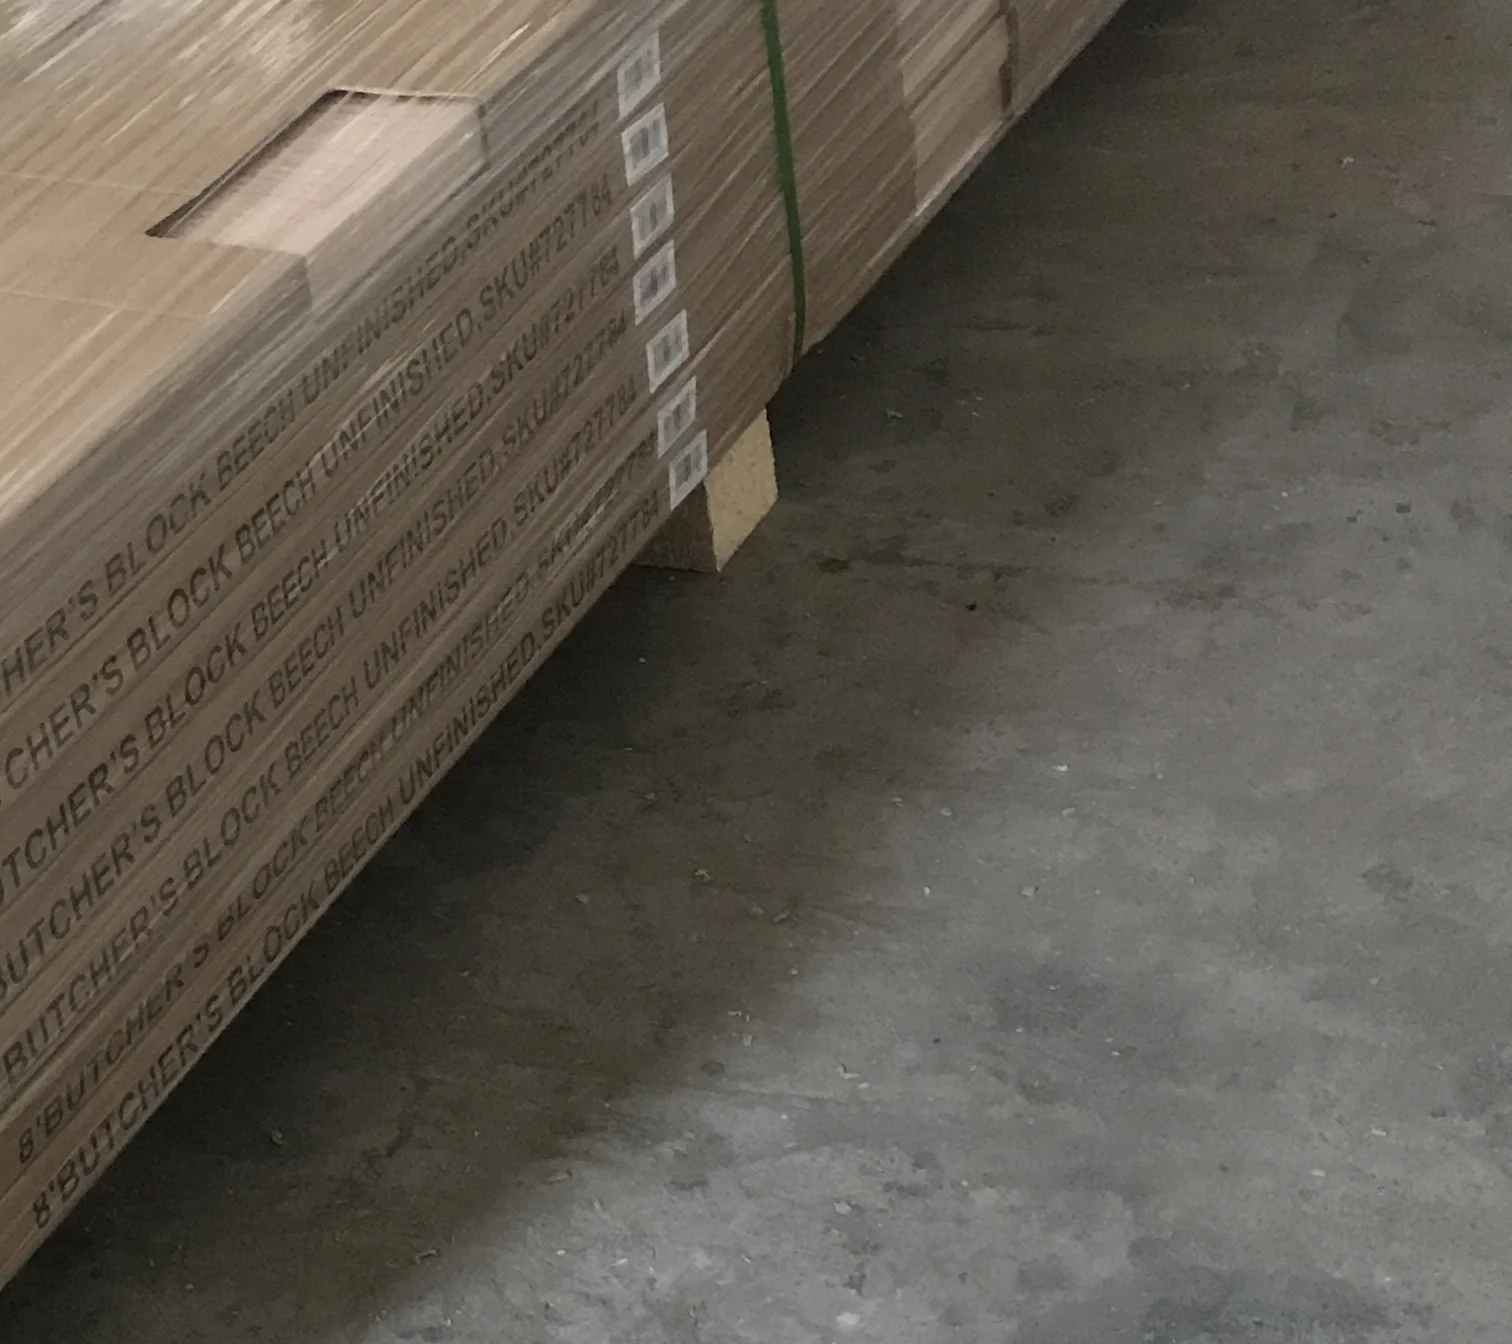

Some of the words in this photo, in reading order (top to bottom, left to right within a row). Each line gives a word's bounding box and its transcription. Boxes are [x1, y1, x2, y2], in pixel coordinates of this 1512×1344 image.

[105, 472, 210, 596] BLOCK
[216, 391, 296, 490] BEECH
[126, 544, 232, 671] BLOCK
[235, 461, 316, 564] BEECH
[144, 622, 247, 748] BLOCK
[250, 539, 329, 641] BEECH
[165, 688, 267, 817] BLOCK
[269, 605, 344, 709] BEECH
[183, 760, 283, 889] BLOCK
[285, 676, 359, 778] BEECH
[19, 943, 209, 1164] 8'BUTCHERS
[217, 814, 308, 942] BLOCK
[315, 730, 386, 832] BEECH
[228, 880, 320, 1004] BLOCK
[323, 794, 394, 894] BEECH
